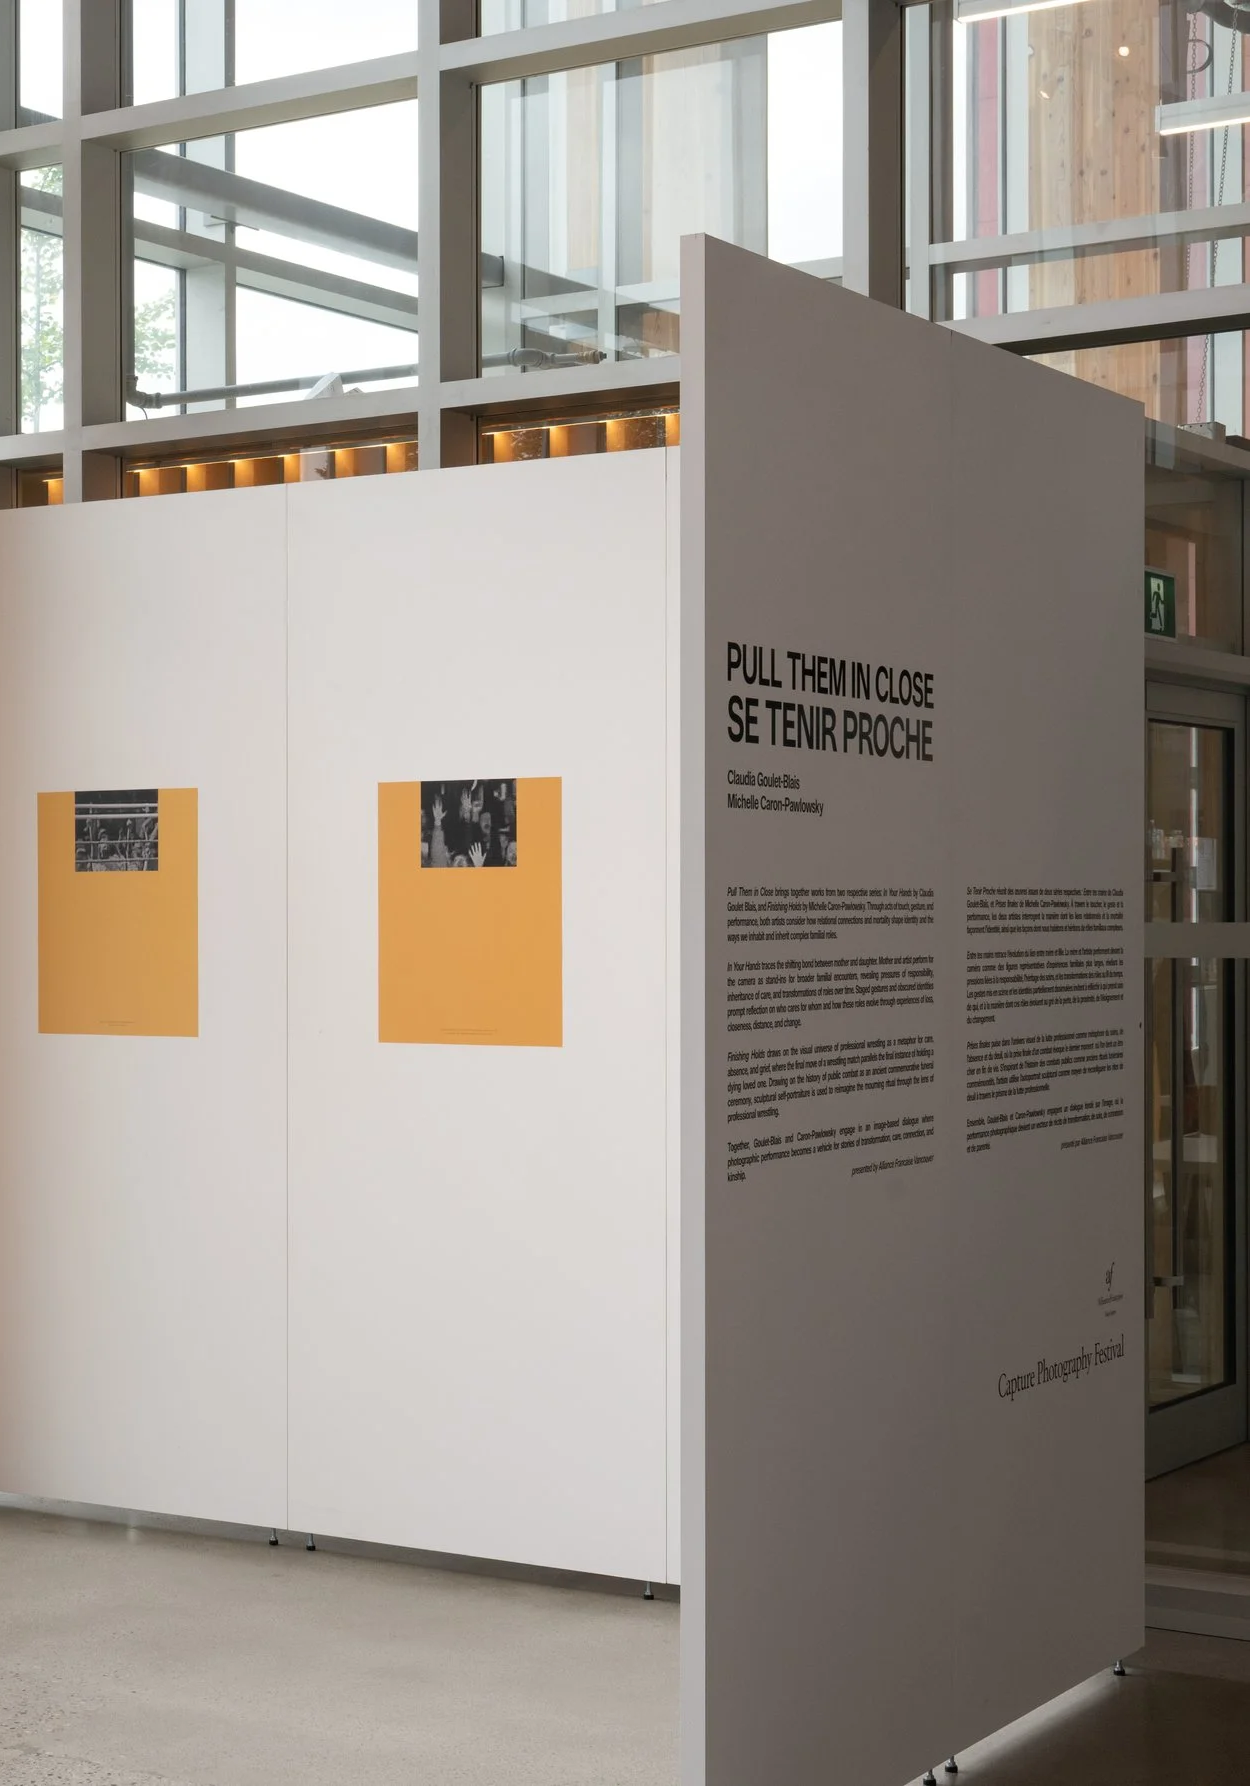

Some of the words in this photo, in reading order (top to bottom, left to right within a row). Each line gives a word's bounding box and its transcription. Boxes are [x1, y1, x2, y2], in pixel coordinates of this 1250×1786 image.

[727, 641, 782, 689] PULL
[786, 650, 847, 697] THEM
[851, 661, 871, 701] IN
[875, 665, 935, 709] CLOSE
[727, 694, 760, 744] SE
[765, 699, 838, 753] TENIR
[843, 709, 934, 762] PROCHE
[727, 769, 756, 787] Claudia
[757, 771, 800, 790] Goulet-Blais
[727, 793, 759, 810] Michelle
[760, 795, 824, 817] Caron-Pawlowsky
[997, 1372, 1036, 1402] Capture
[1036, 1346, 1093, 1386] Photography
[1094, 1333, 1125, 1366] Festival
